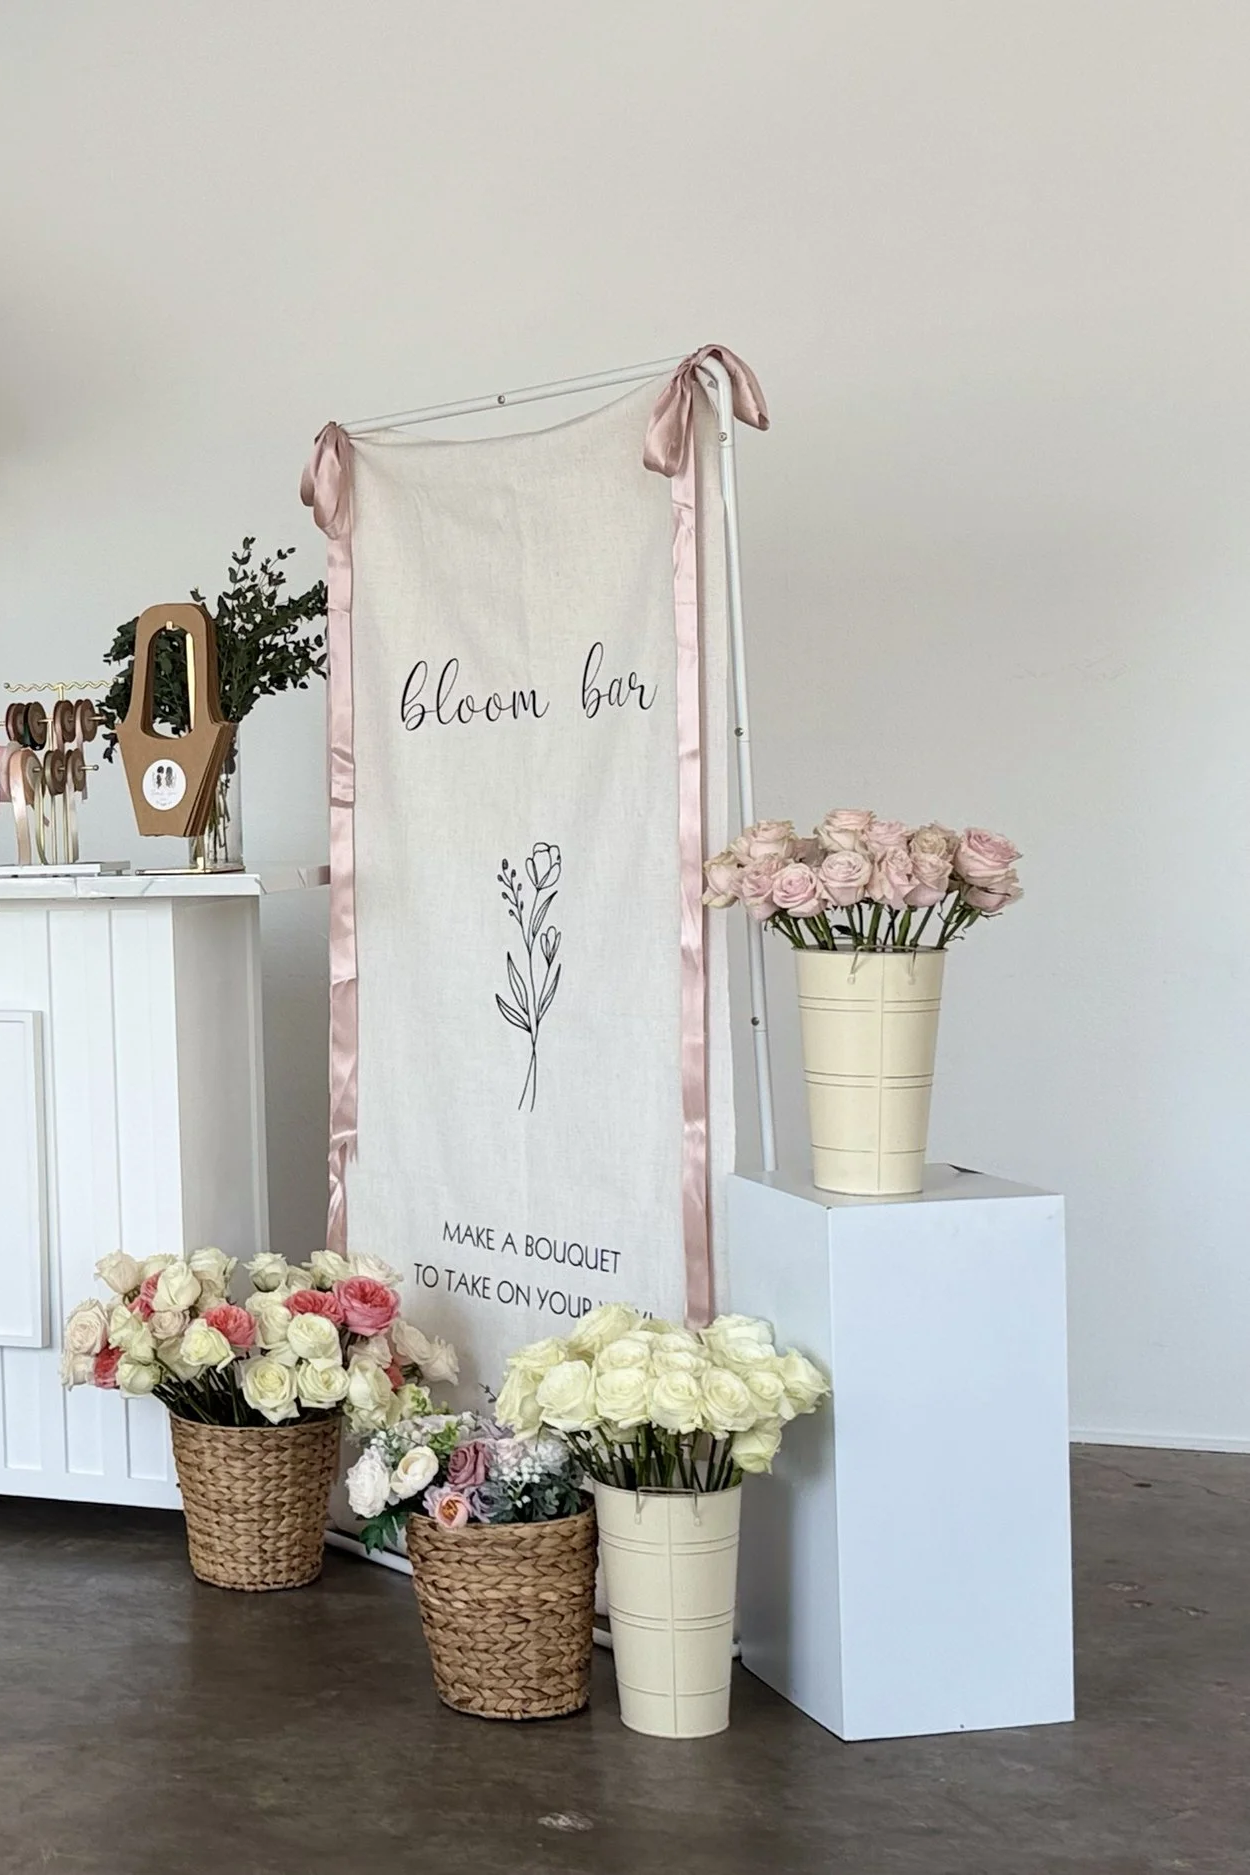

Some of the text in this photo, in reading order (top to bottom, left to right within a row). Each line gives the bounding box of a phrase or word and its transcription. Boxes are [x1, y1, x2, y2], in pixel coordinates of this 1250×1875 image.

[400, 641, 658, 732] bloom bar
[442, 1221, 622, 1274] MAKE A BOUQUET
[414, 1262, 439, 1288] TO
[445, 1269, 491, 1300] TAKE
[496, 1280, 531, 1308] ON
